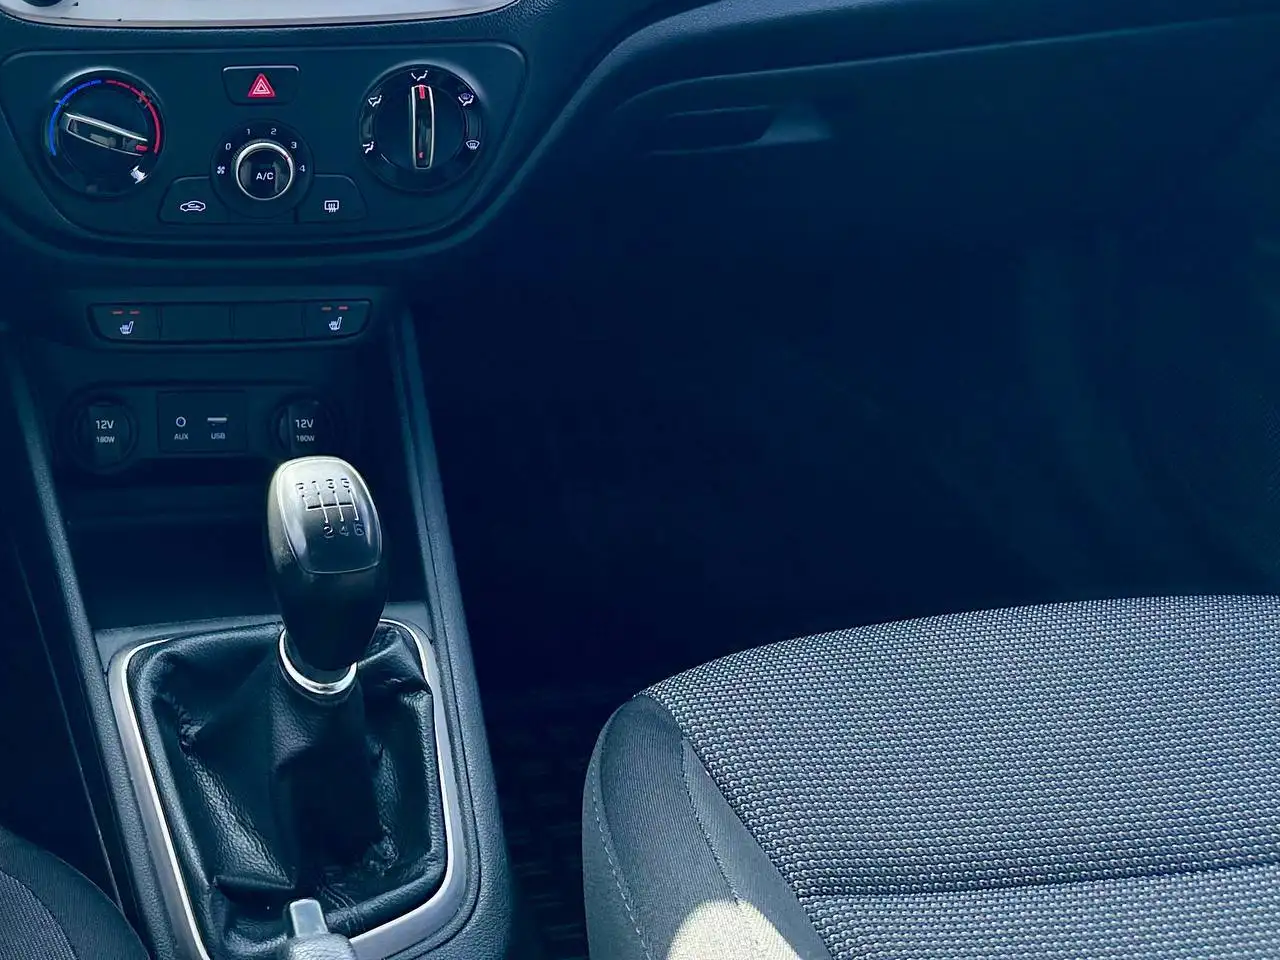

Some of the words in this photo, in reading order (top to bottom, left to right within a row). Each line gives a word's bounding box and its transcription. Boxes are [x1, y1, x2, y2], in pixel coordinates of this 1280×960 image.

[246, 128, 251, 136] 1
[270, 127, 277, 136] 2
[225, 142, 232, 151] 0
[290, 141, 297, 149] 3
[299, 164, 306, 173] 4
[255, 172, 274, 181] A/C
[96, 419, 114, 430] 12V
[295, 418, 314, 429] 12V
[173, 432, 189, 441] AUX
[210, 432, 226, 440] USB
[325, 478, 337, 490] 3
[323, 525, 334, 539] 2
[339, 525, 349, 536] 4
